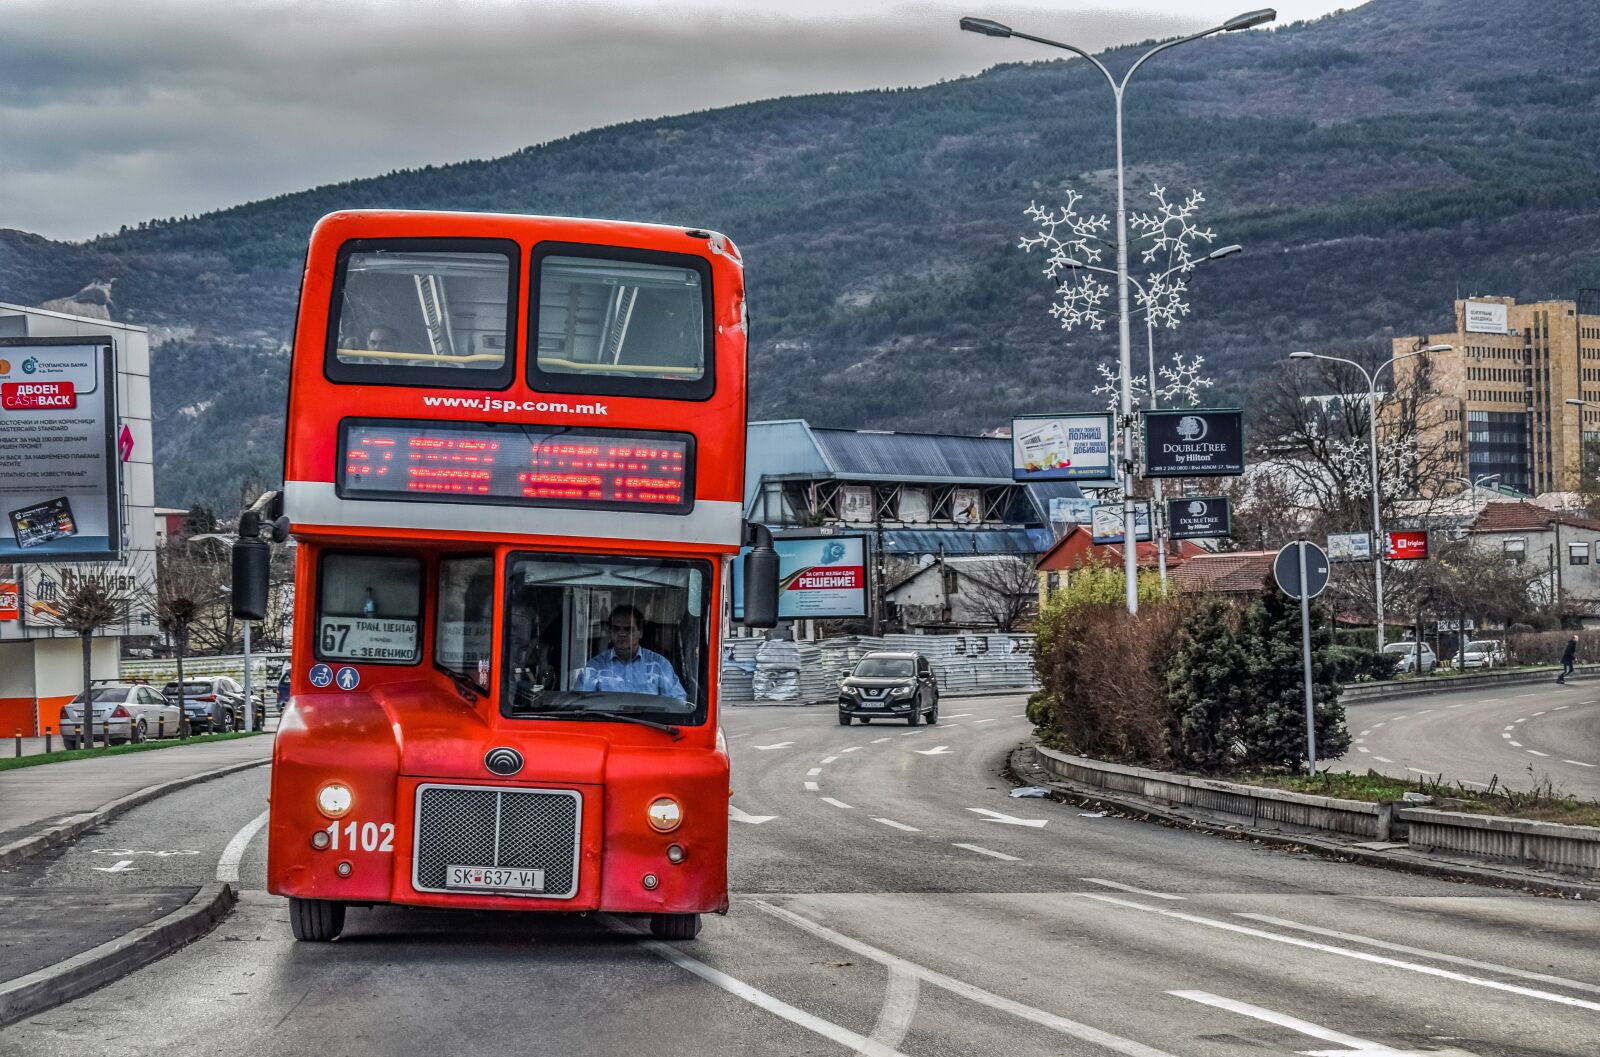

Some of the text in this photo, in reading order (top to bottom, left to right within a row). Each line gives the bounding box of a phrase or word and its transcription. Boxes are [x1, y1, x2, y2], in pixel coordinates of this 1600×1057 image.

[17, 384, 58, 396] ДВОЕН
[6, 396, 70, 406] CASHBACK
[424, 396, 608, 415] www.jsp.com.mk
[1068, 432, 1101, 440] ПОЛНИШ
[1176, 454, 1185, 463] by
[800, 576, 855, 588] РЕШЕНИЕ!
[322, 624, 350, 652] 67
[327, 820, 394, 852] 1102
